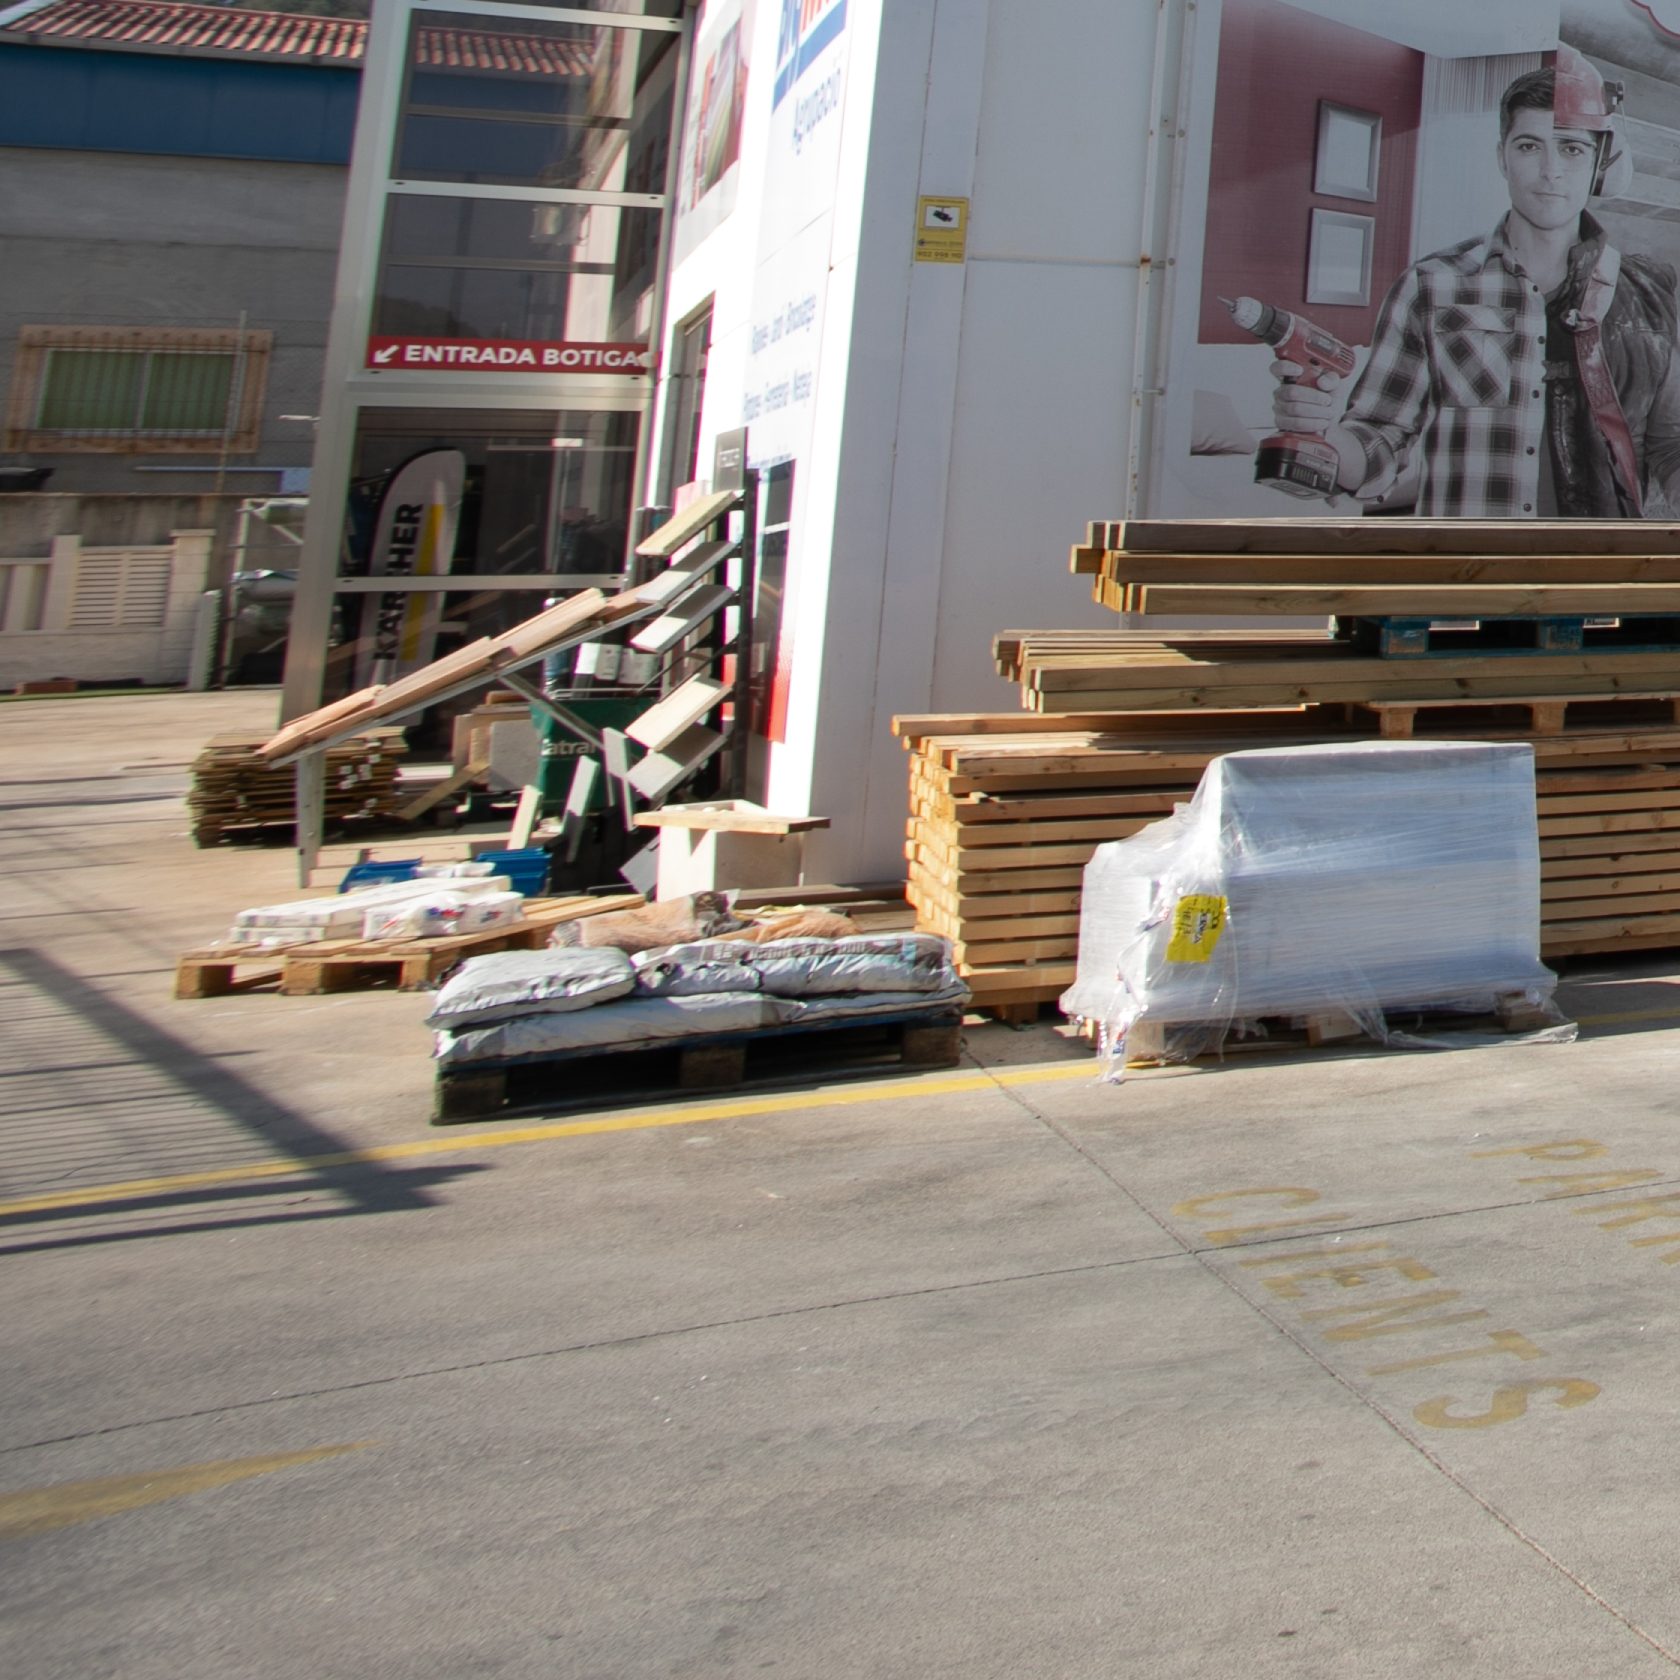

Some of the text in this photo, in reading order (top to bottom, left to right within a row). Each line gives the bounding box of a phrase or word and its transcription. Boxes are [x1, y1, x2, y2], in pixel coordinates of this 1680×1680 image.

[404, 344, 640, 367] ENTRADA BOTIGA
[373, 503, 425, 661] KÄRHER
[1171, 1185, 1601, 1430] CLIENTS
